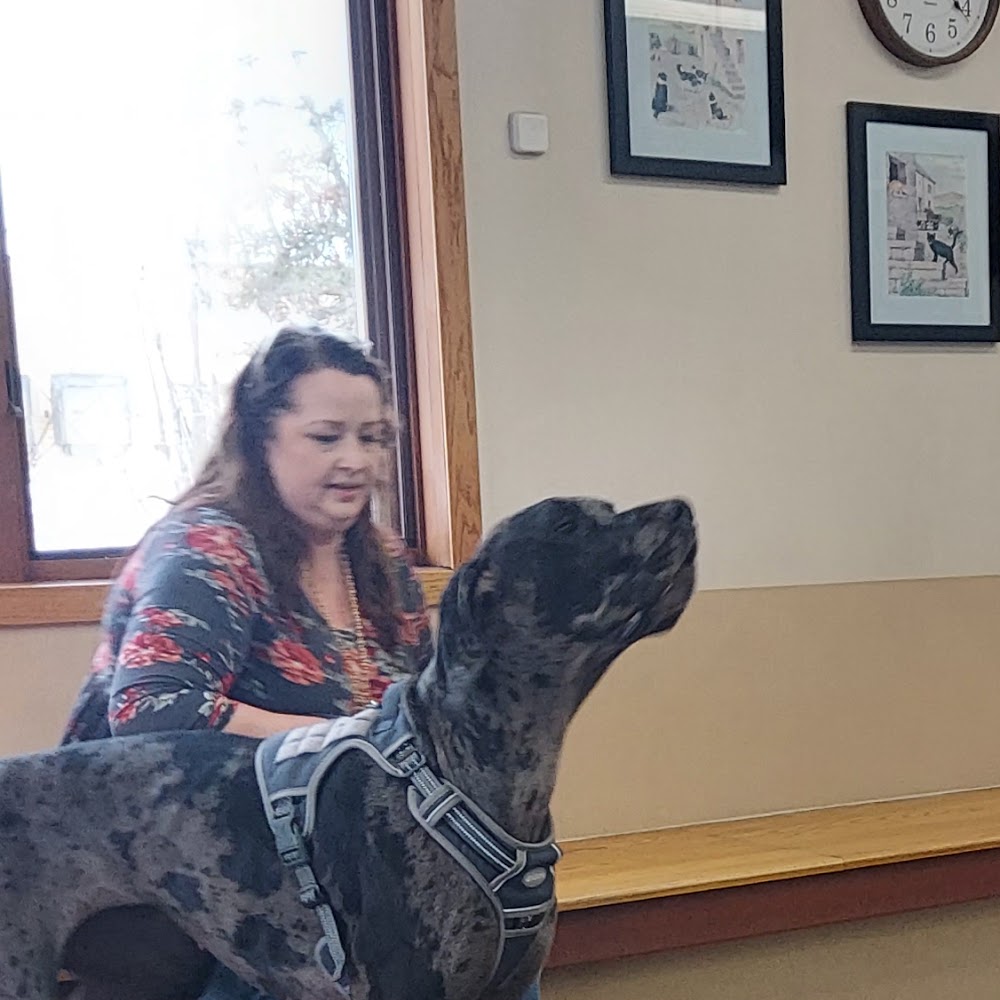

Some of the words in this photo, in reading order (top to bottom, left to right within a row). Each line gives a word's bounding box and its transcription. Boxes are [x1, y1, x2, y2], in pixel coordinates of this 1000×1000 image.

[962, 0, 971, 17] 4
[903, 12, 912, 34] 7
[925, 22, 936, 44] 6
[948, 18, 957, 39] 5
